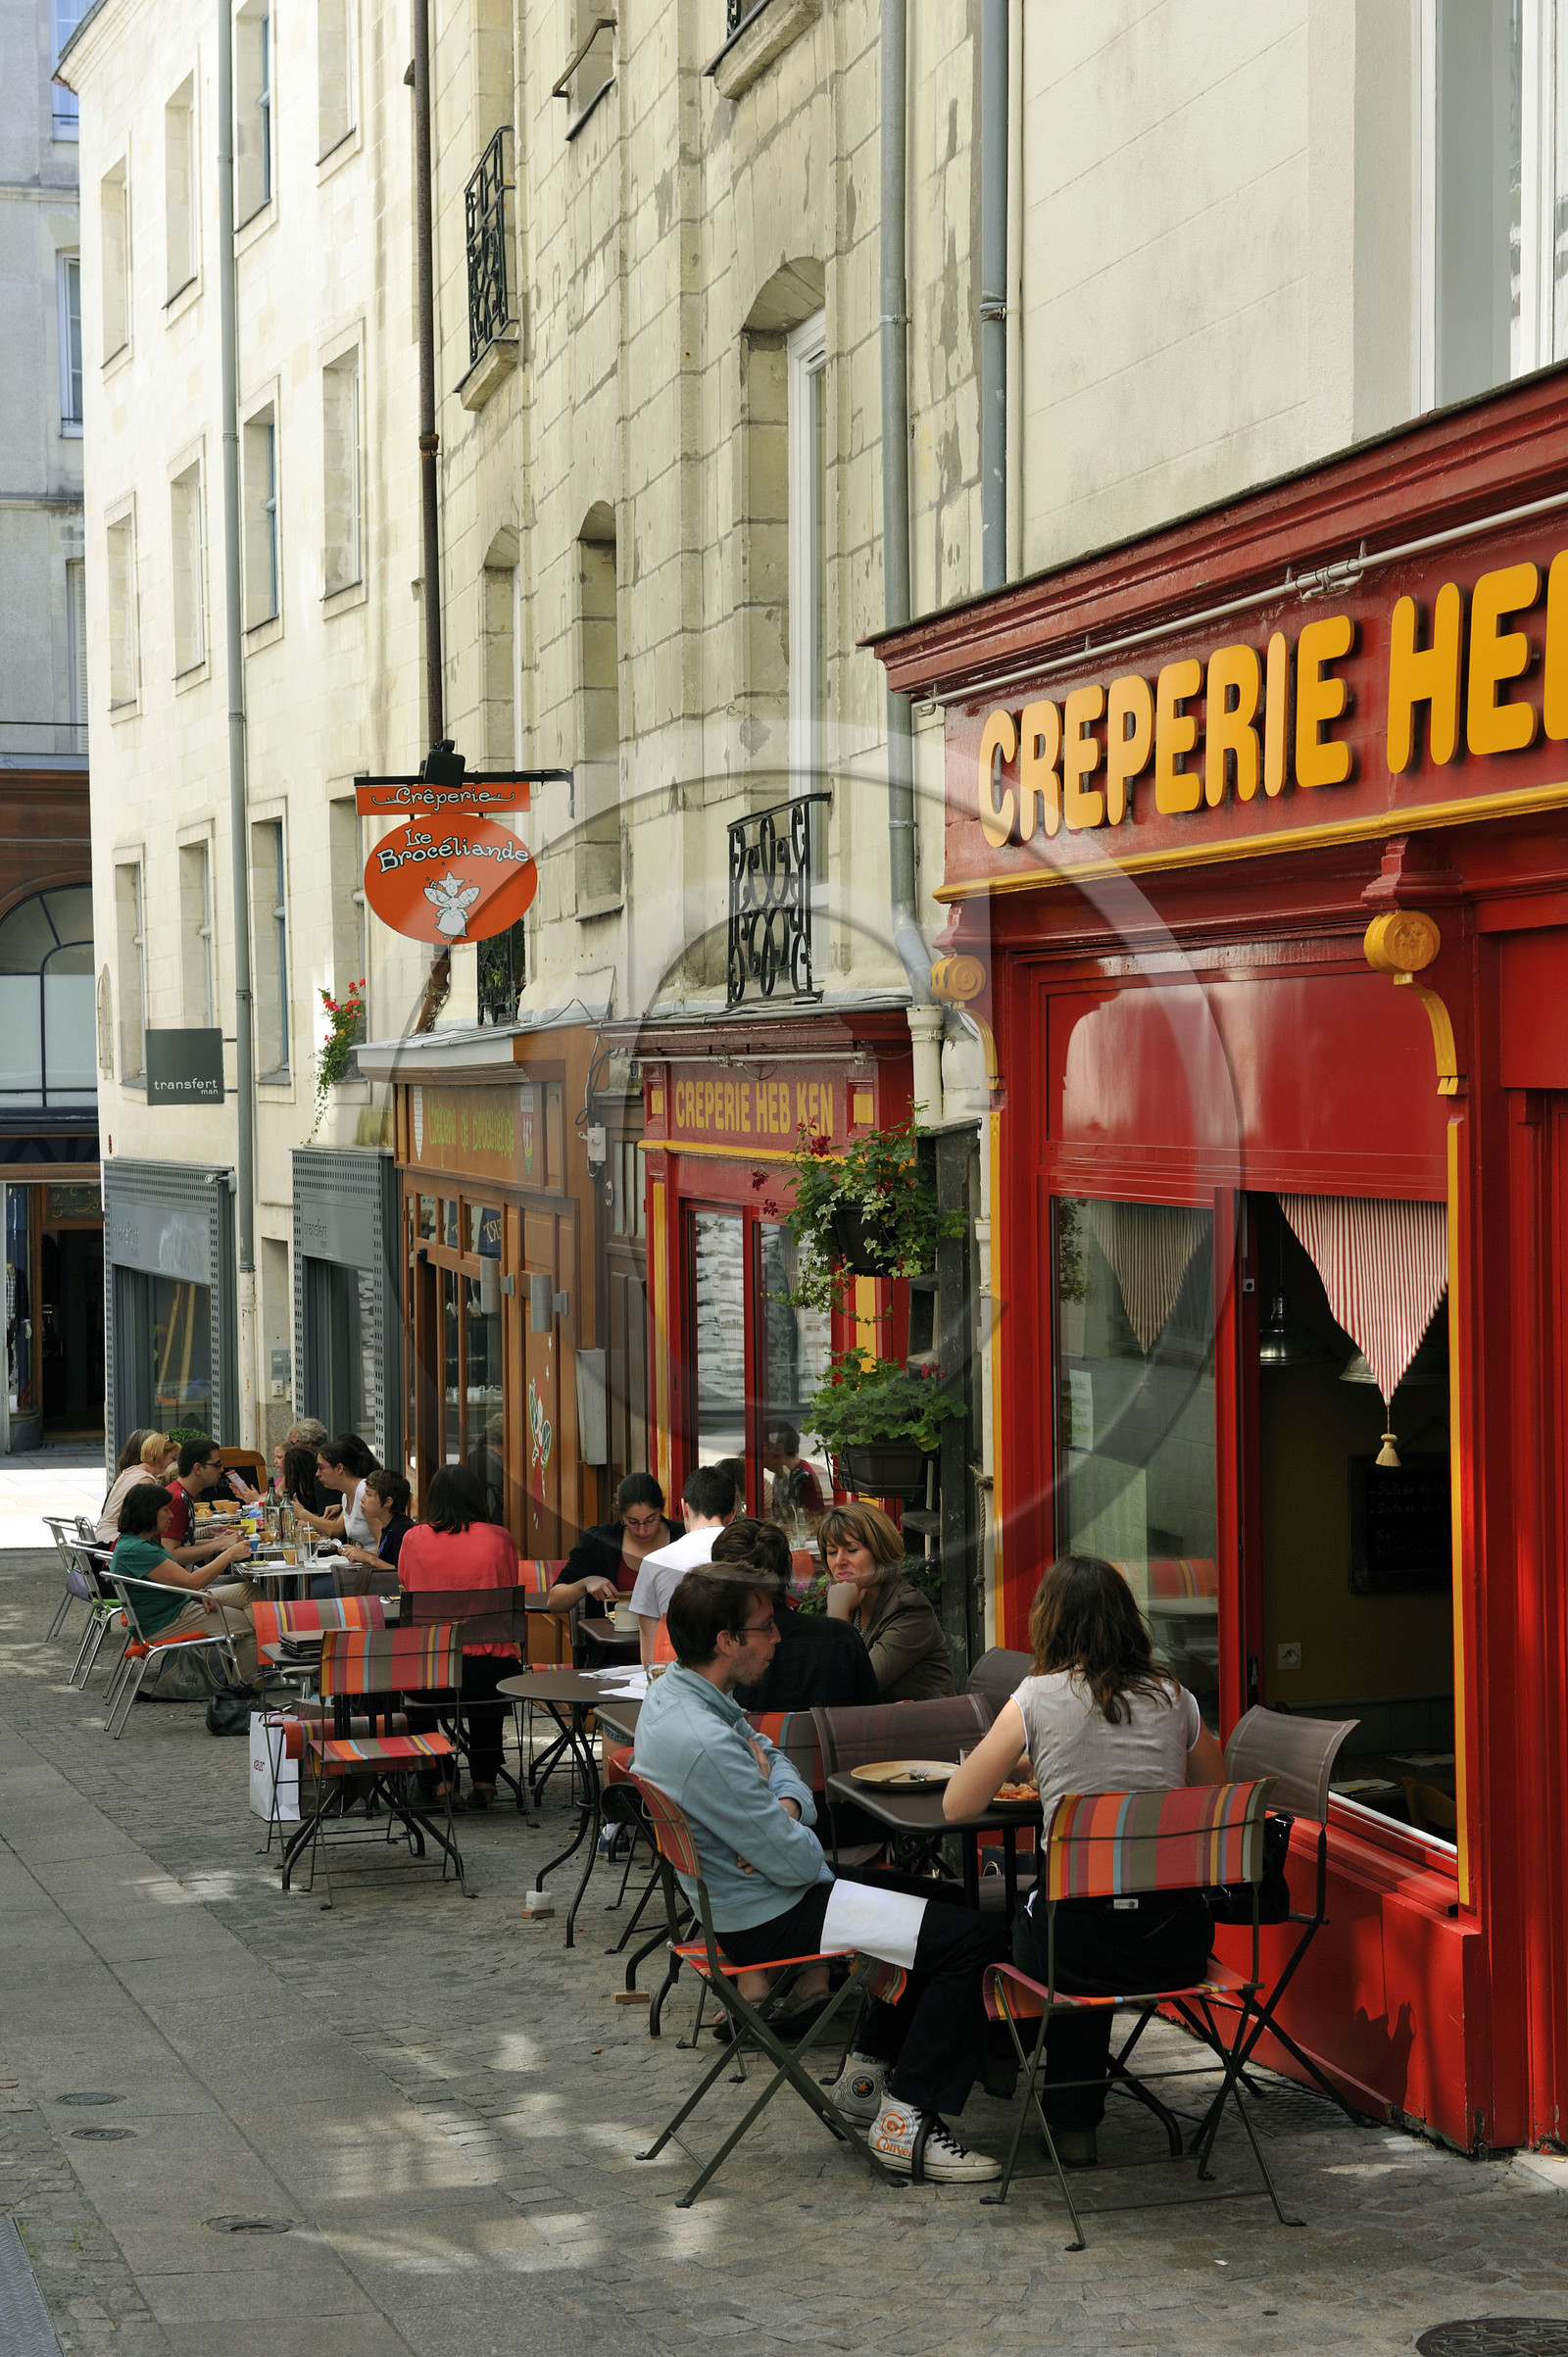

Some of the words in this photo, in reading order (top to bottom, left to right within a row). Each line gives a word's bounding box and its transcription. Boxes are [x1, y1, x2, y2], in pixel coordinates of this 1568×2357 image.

[980, 614, 1355, 848] CREPERIE
[393, 786, 494, 811] Crêperie
[405, 828, 432, 847] Le
[376, 836, 530, 873] Brocéliande
[154, 1077, 219, 1090] transfert
[675, 1080, 751, 1133] CREPERIE
[755, 1082, 791, 1134] HEB
[796, 1081, 833, 1138] KEN
